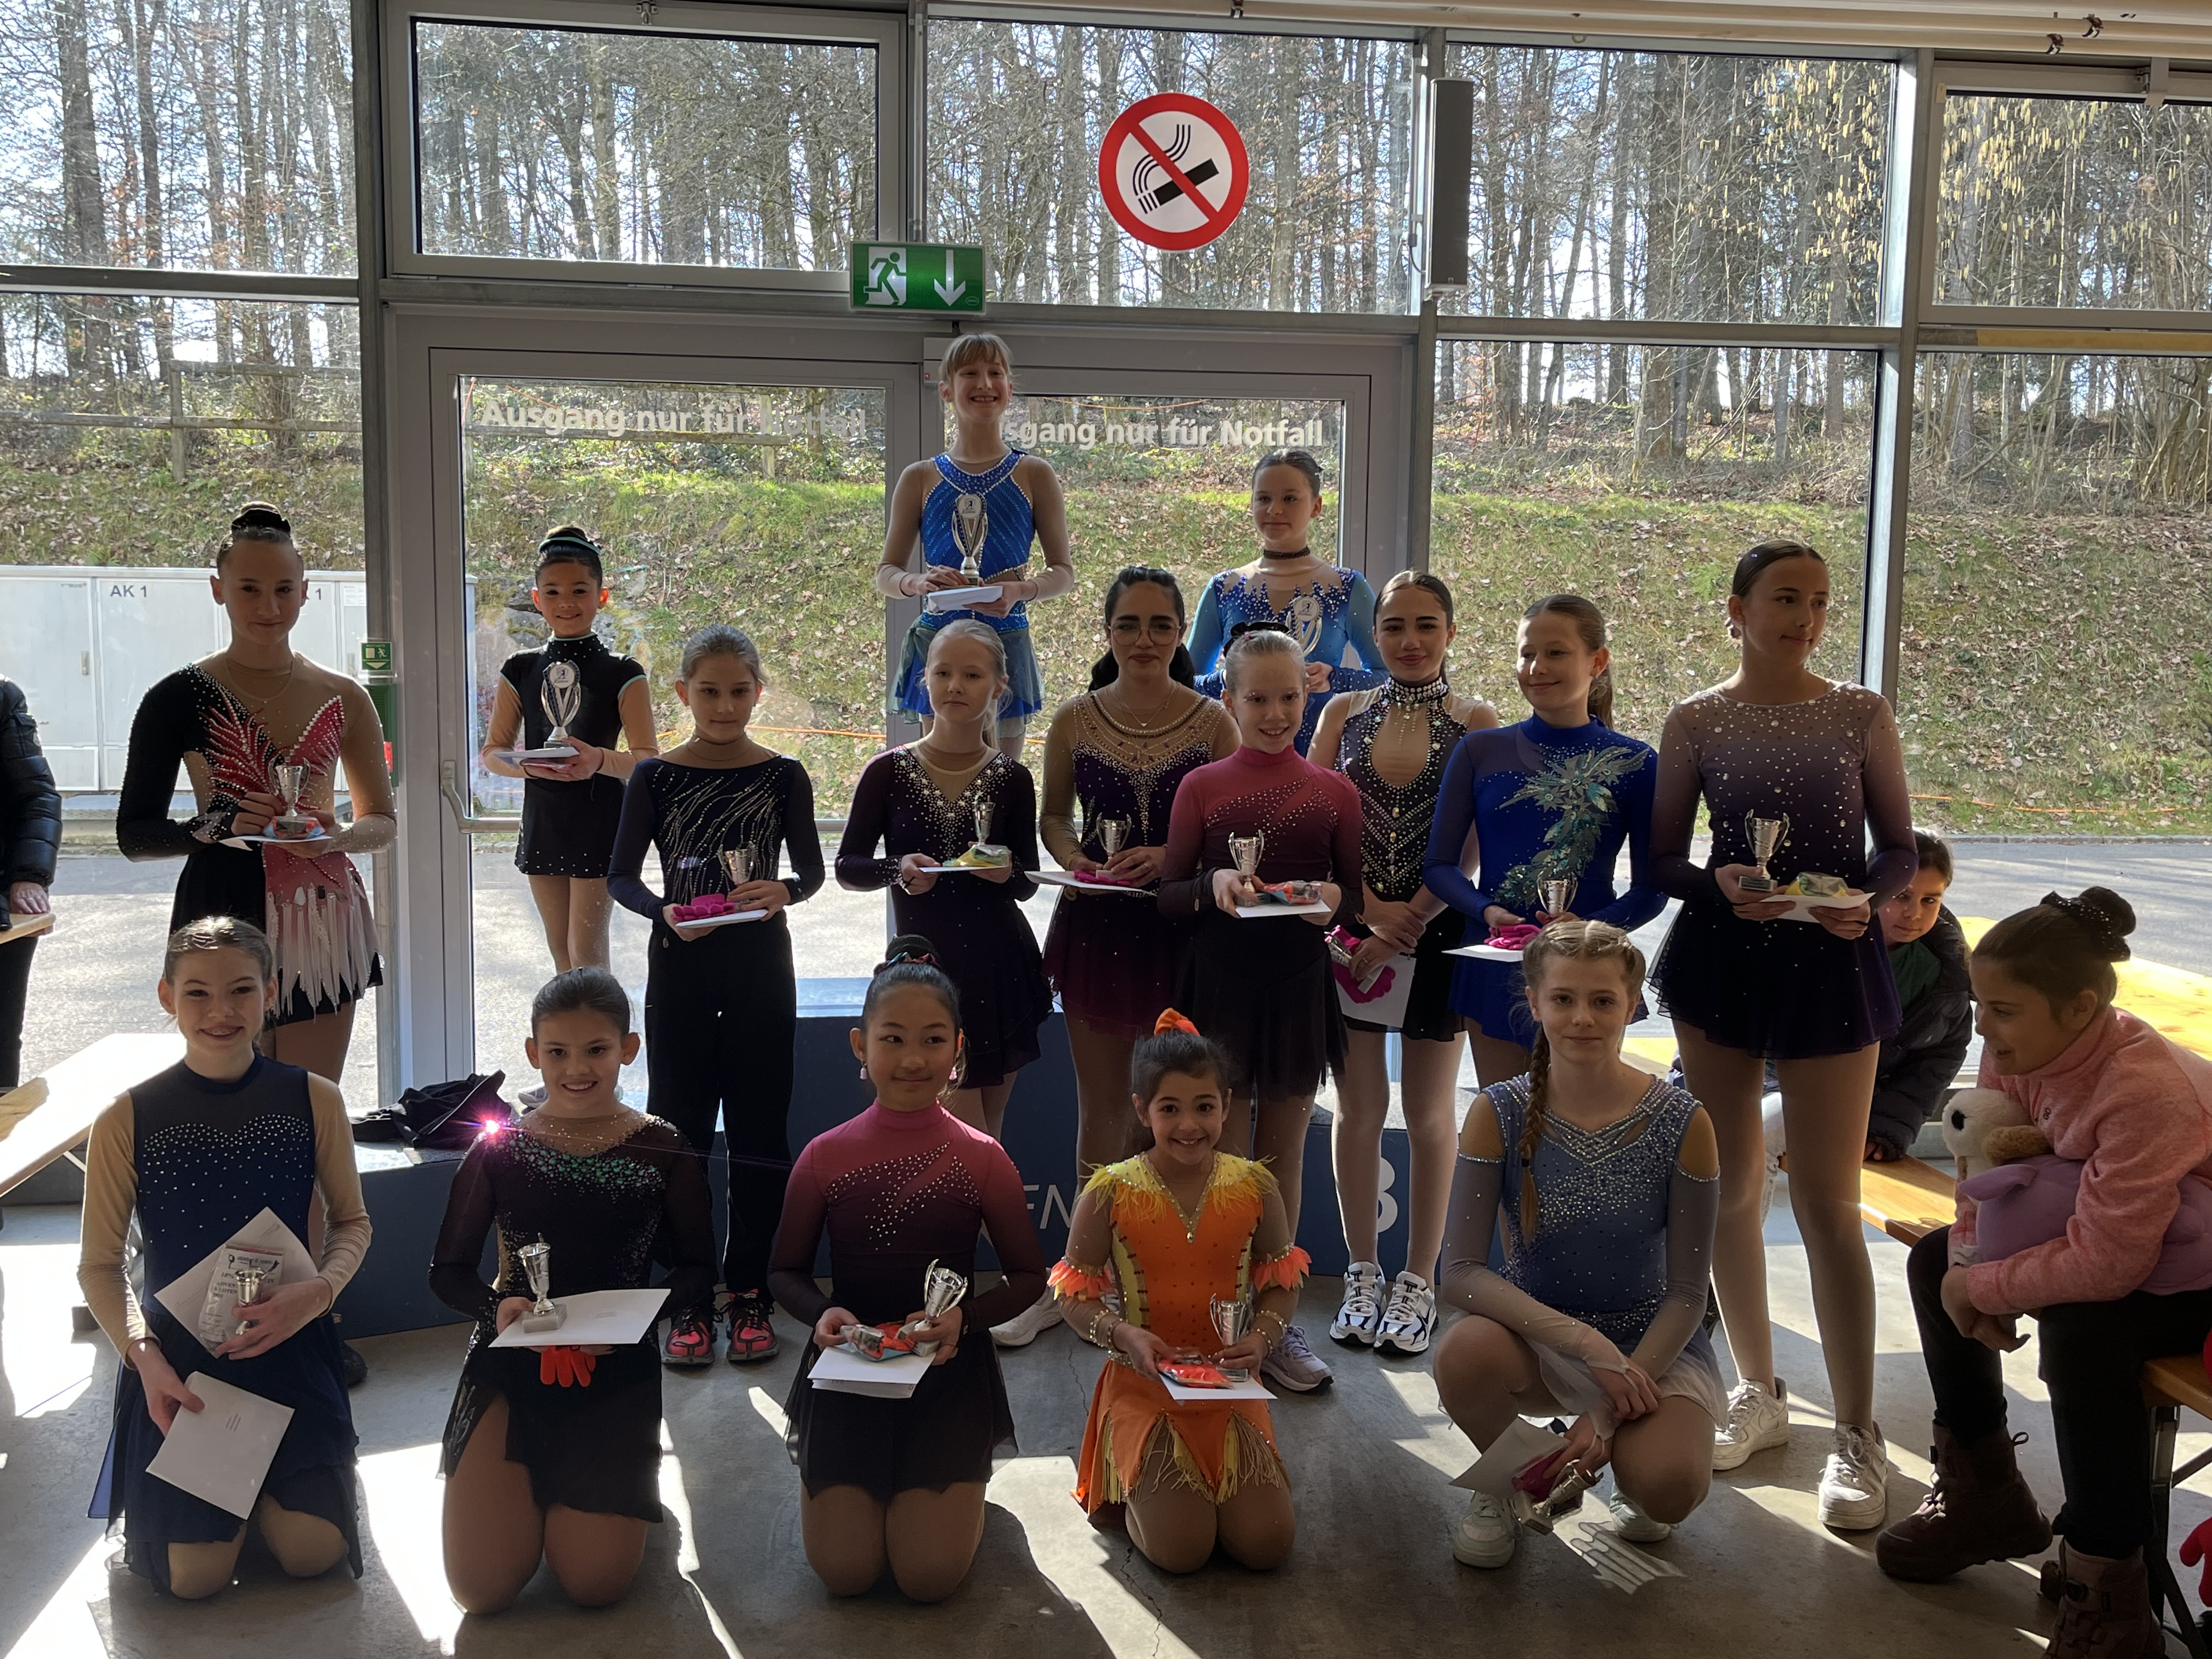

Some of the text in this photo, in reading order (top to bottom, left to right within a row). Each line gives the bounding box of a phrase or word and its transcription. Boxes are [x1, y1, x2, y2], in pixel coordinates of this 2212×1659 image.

[481, 399, 625, 437] Ausgang
[637, 410, 692, 432] nur
[702, 404, 748, 433] für
[998, 415, 1323, 450] sgang nur für Notfall
[110, 585, 147, 598] AK 1
[315, 588, 321, 601] 1
